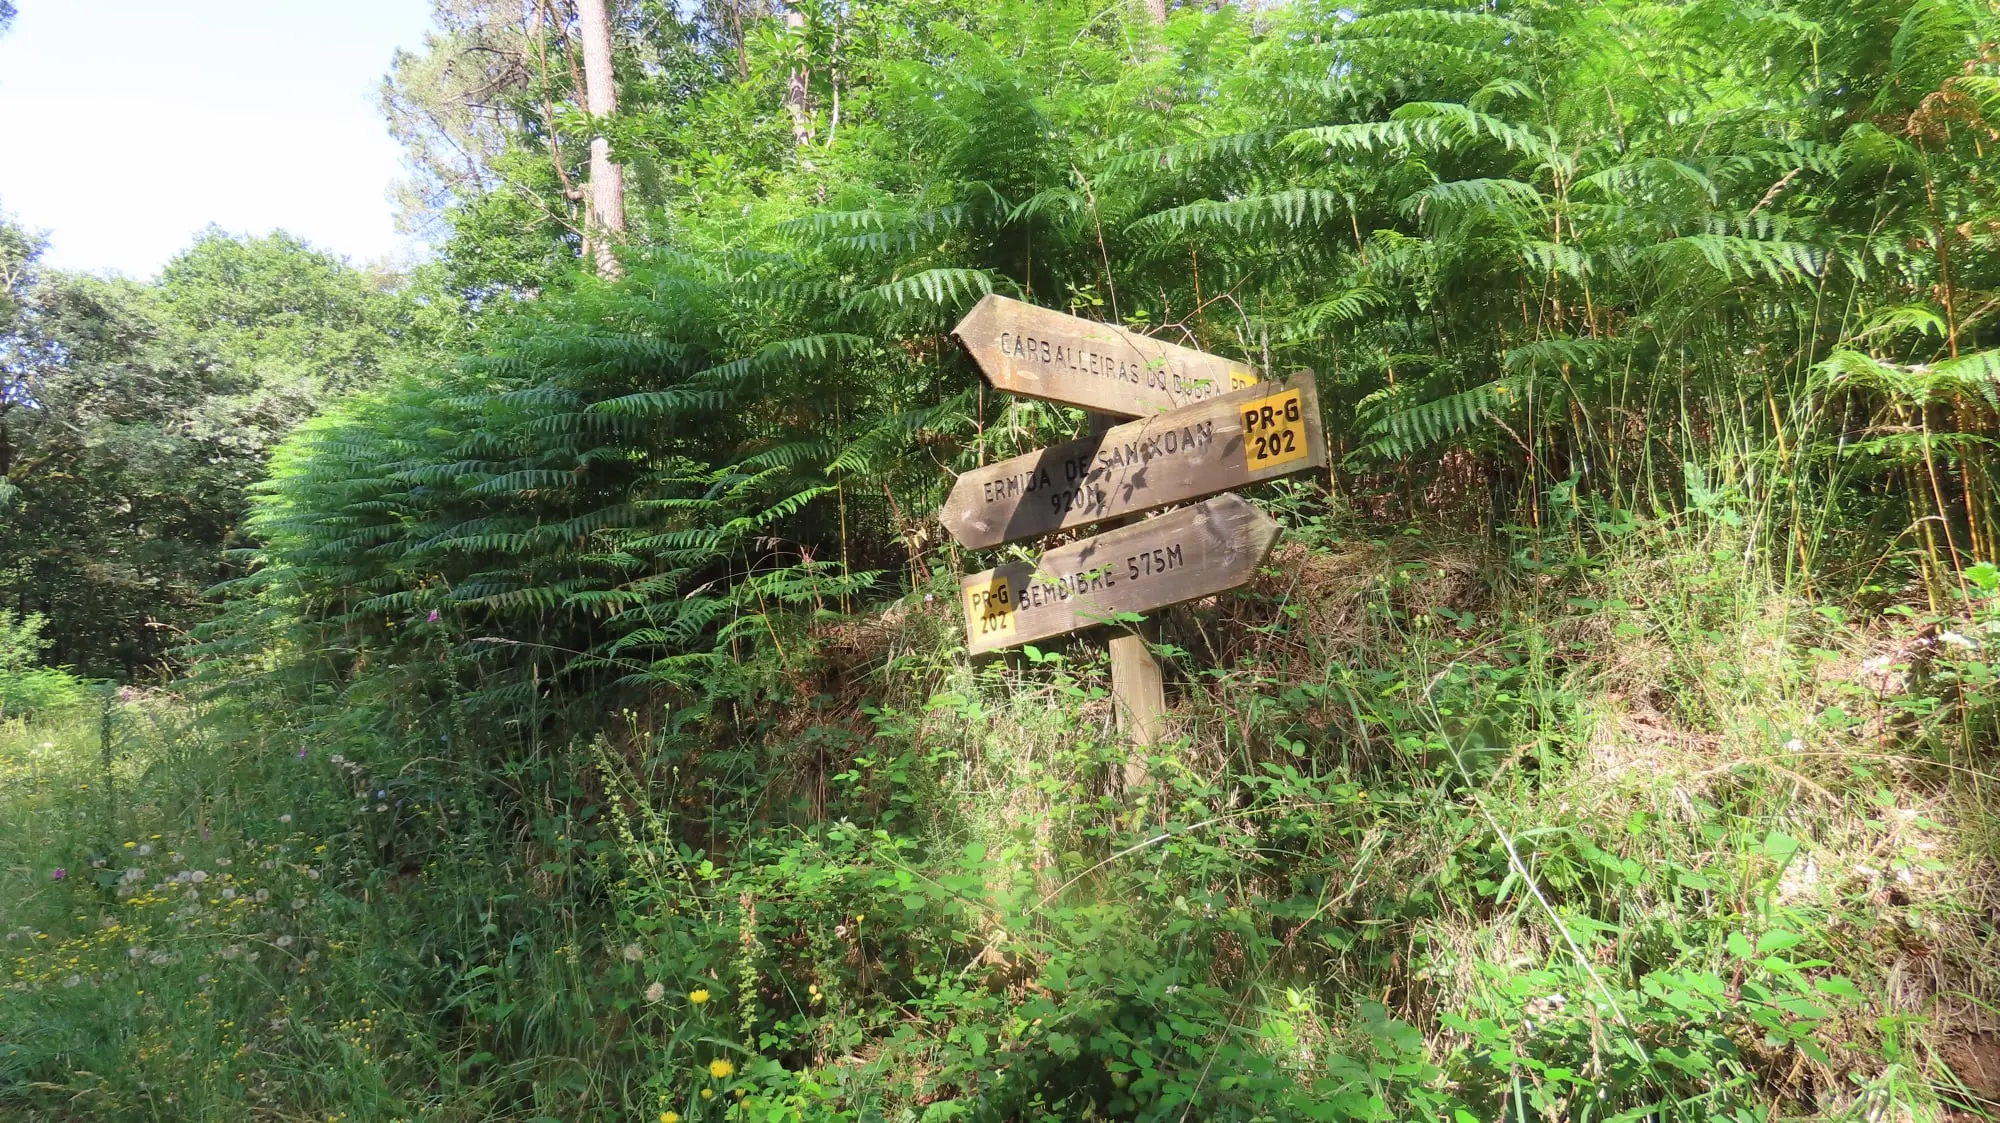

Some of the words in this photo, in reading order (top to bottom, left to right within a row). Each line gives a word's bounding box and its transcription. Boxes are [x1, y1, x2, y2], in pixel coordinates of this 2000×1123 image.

[1001, 332, 1139, 384] CARBALLEIRAS
[1146, 367, 1166, 391] DO
[1245, 398, 1299, 433] PR-G
[984, 467, 1051, 503] ERMIDA
[1065, 456, 1089, 482] DE
[1098, 441, 1138, 470] SAN
[1147, 420, 1213, 456] XOAN
[1255, 430, 1296, 459] 202
[1051, 482, 1101, 515] 920M
[1127, 544, 1184, 581] 575M
[972, 584, 1009, 613] PR-G
[981, 611, 1008, 634] 202
